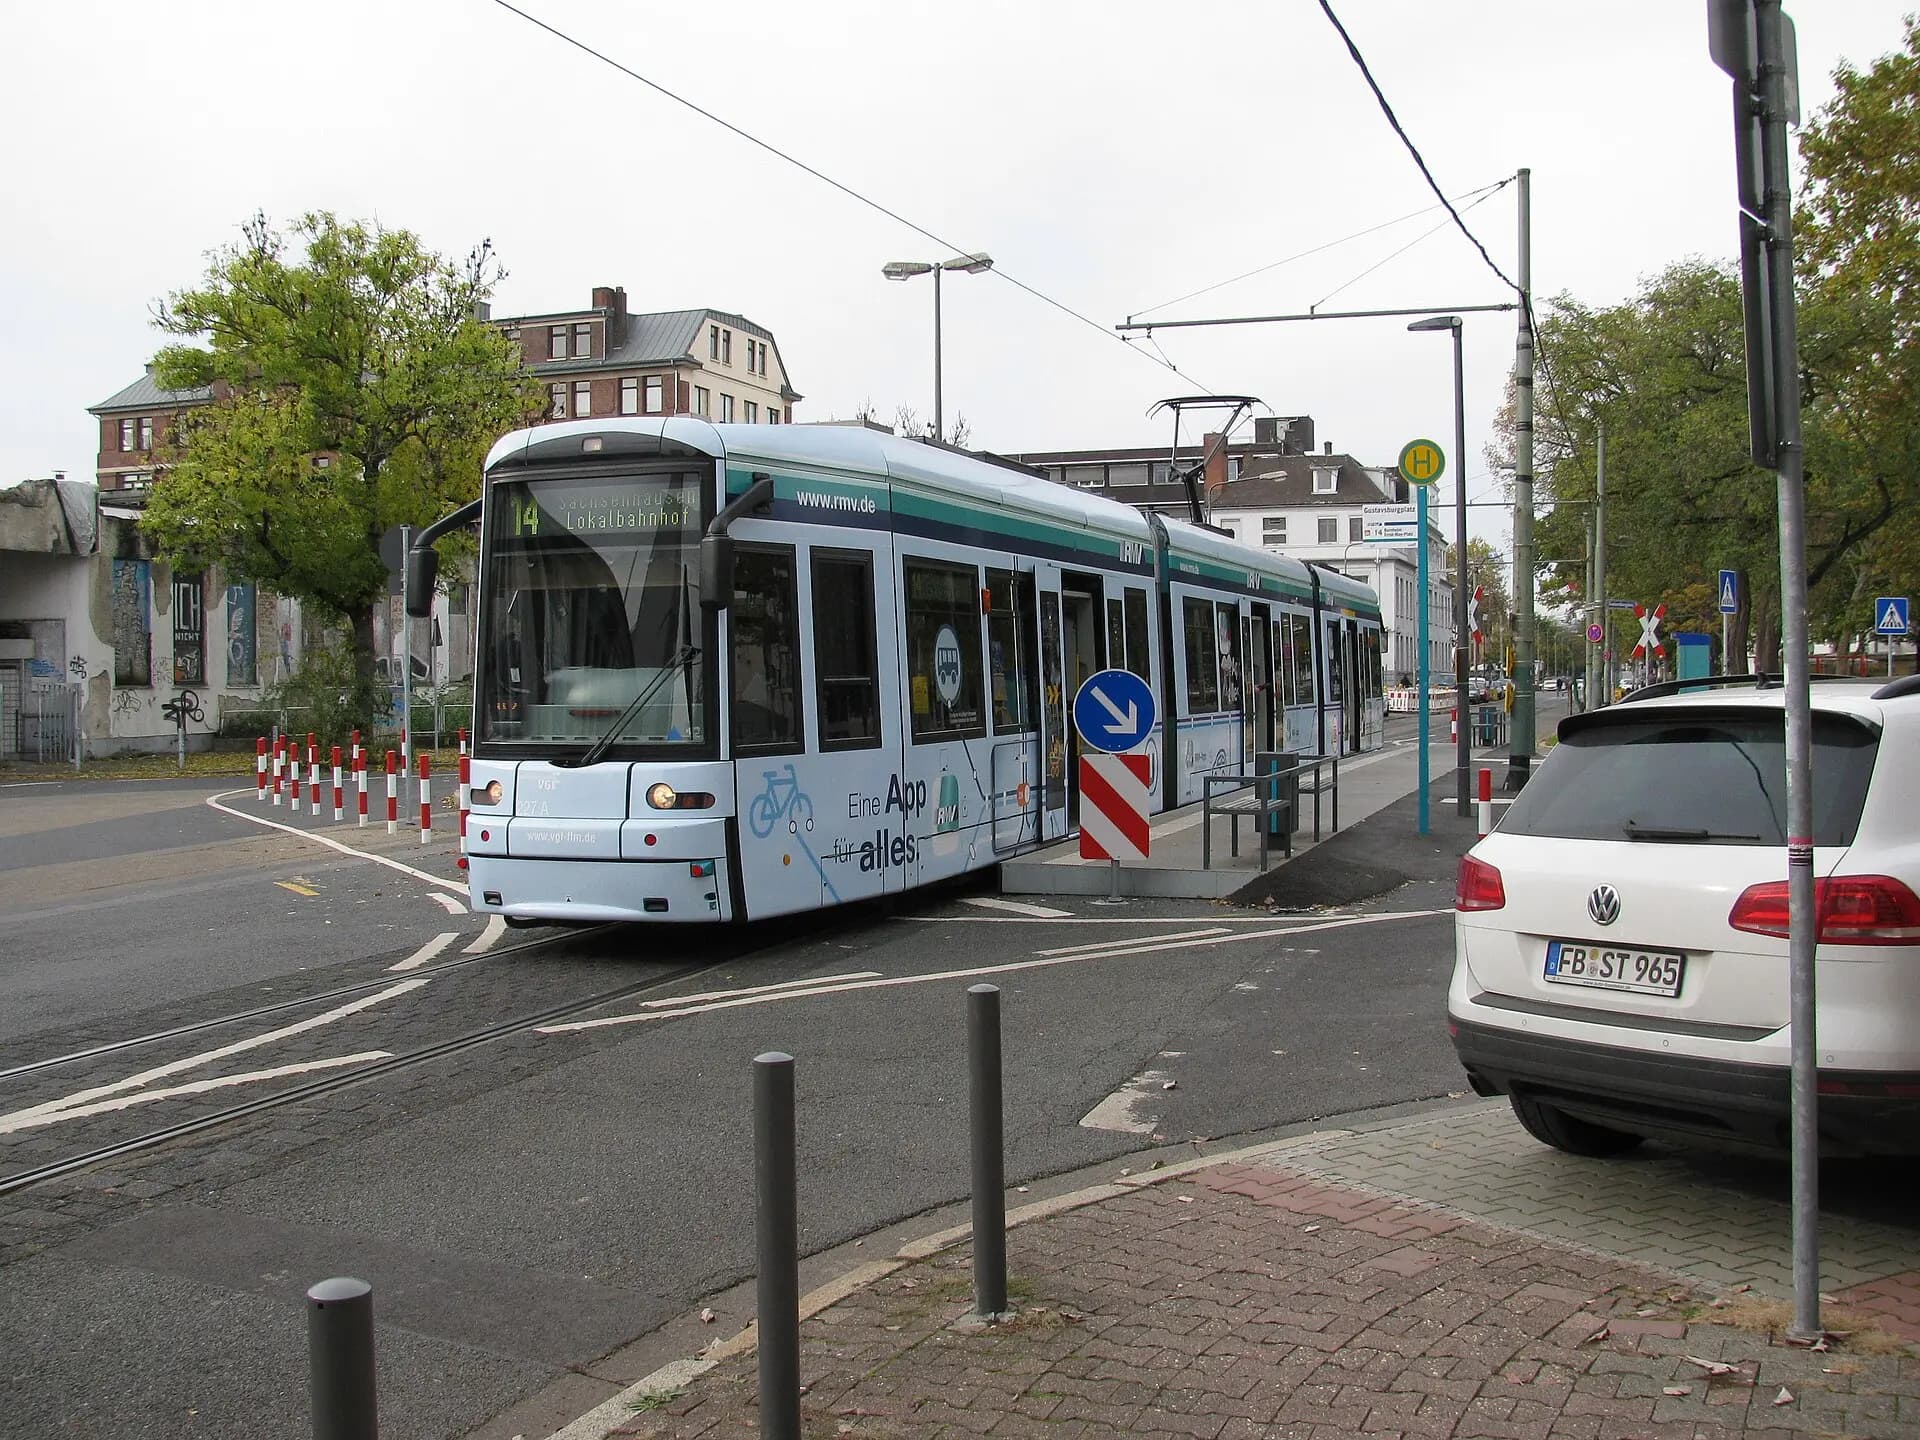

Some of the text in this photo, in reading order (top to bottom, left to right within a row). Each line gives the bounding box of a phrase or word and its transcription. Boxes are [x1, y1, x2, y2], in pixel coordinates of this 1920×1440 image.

[1412, 449, 1431, 475] H
[511, 496, 540, 536] 14
[796, 490, 877, 514] www.rmv.de
[566, 504, 690, 531] Lokalbahnhof
[175, 583, 200, 631] ICH
[175, 633, 200, 641] NICHT
[848, 773, 927, 821] Eine App
[833, 836, 855, 864] für
[1558, 947, 1679, 986] FB ST 965
